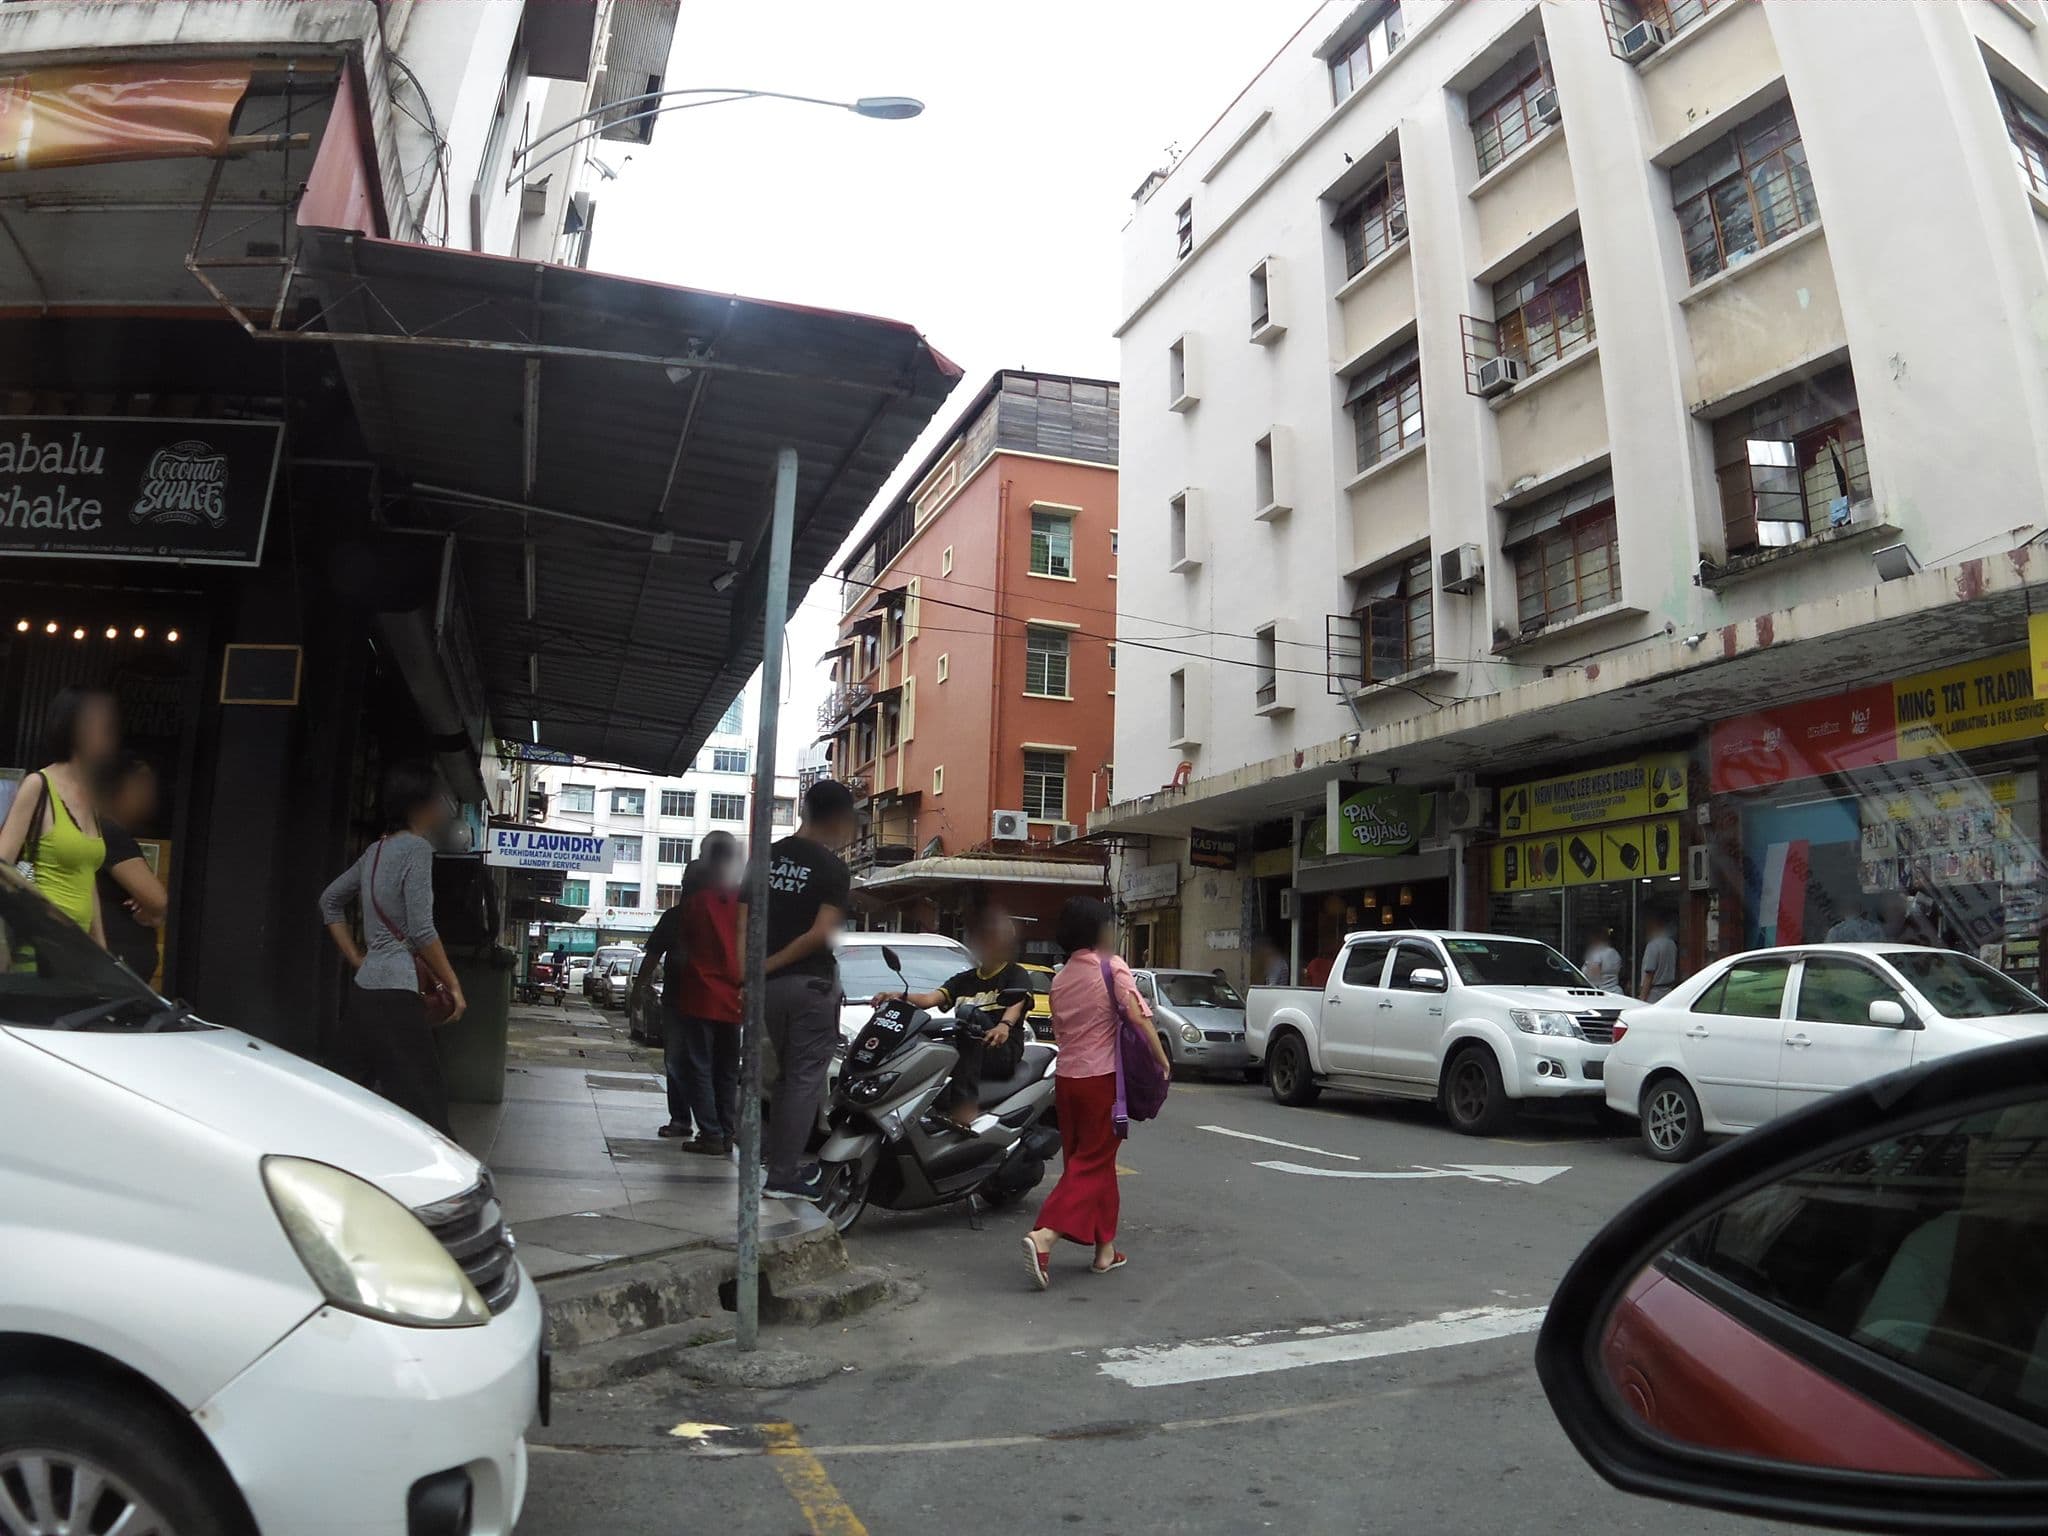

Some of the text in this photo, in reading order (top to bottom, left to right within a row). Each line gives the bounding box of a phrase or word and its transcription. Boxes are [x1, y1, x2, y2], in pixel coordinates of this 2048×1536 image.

[0, 432, 105, 475] abalu
[1897, 688, 1936, 723] MING
[1941, 681, 1966, 714] TAT
[1974, 668, 2034, 707] TRADIN
[1851, 707, 1871, 724] No.1
[1998, 709, 2013, 726] FAX
[2015, 702, 2046, 722] SERVICE
[498, 831, 604, 854] E.V LAUNDRY
[500, 848, 601, 863] PERKHIDMATAN CUCI PAKAIAN
[519, 858, 581, 870] LAUNDRY SERVICE
[769, 861, 812, 880] LANE
[768, 875, 806, 894] RAZY
[885, 1009, 901, 1020] SB
